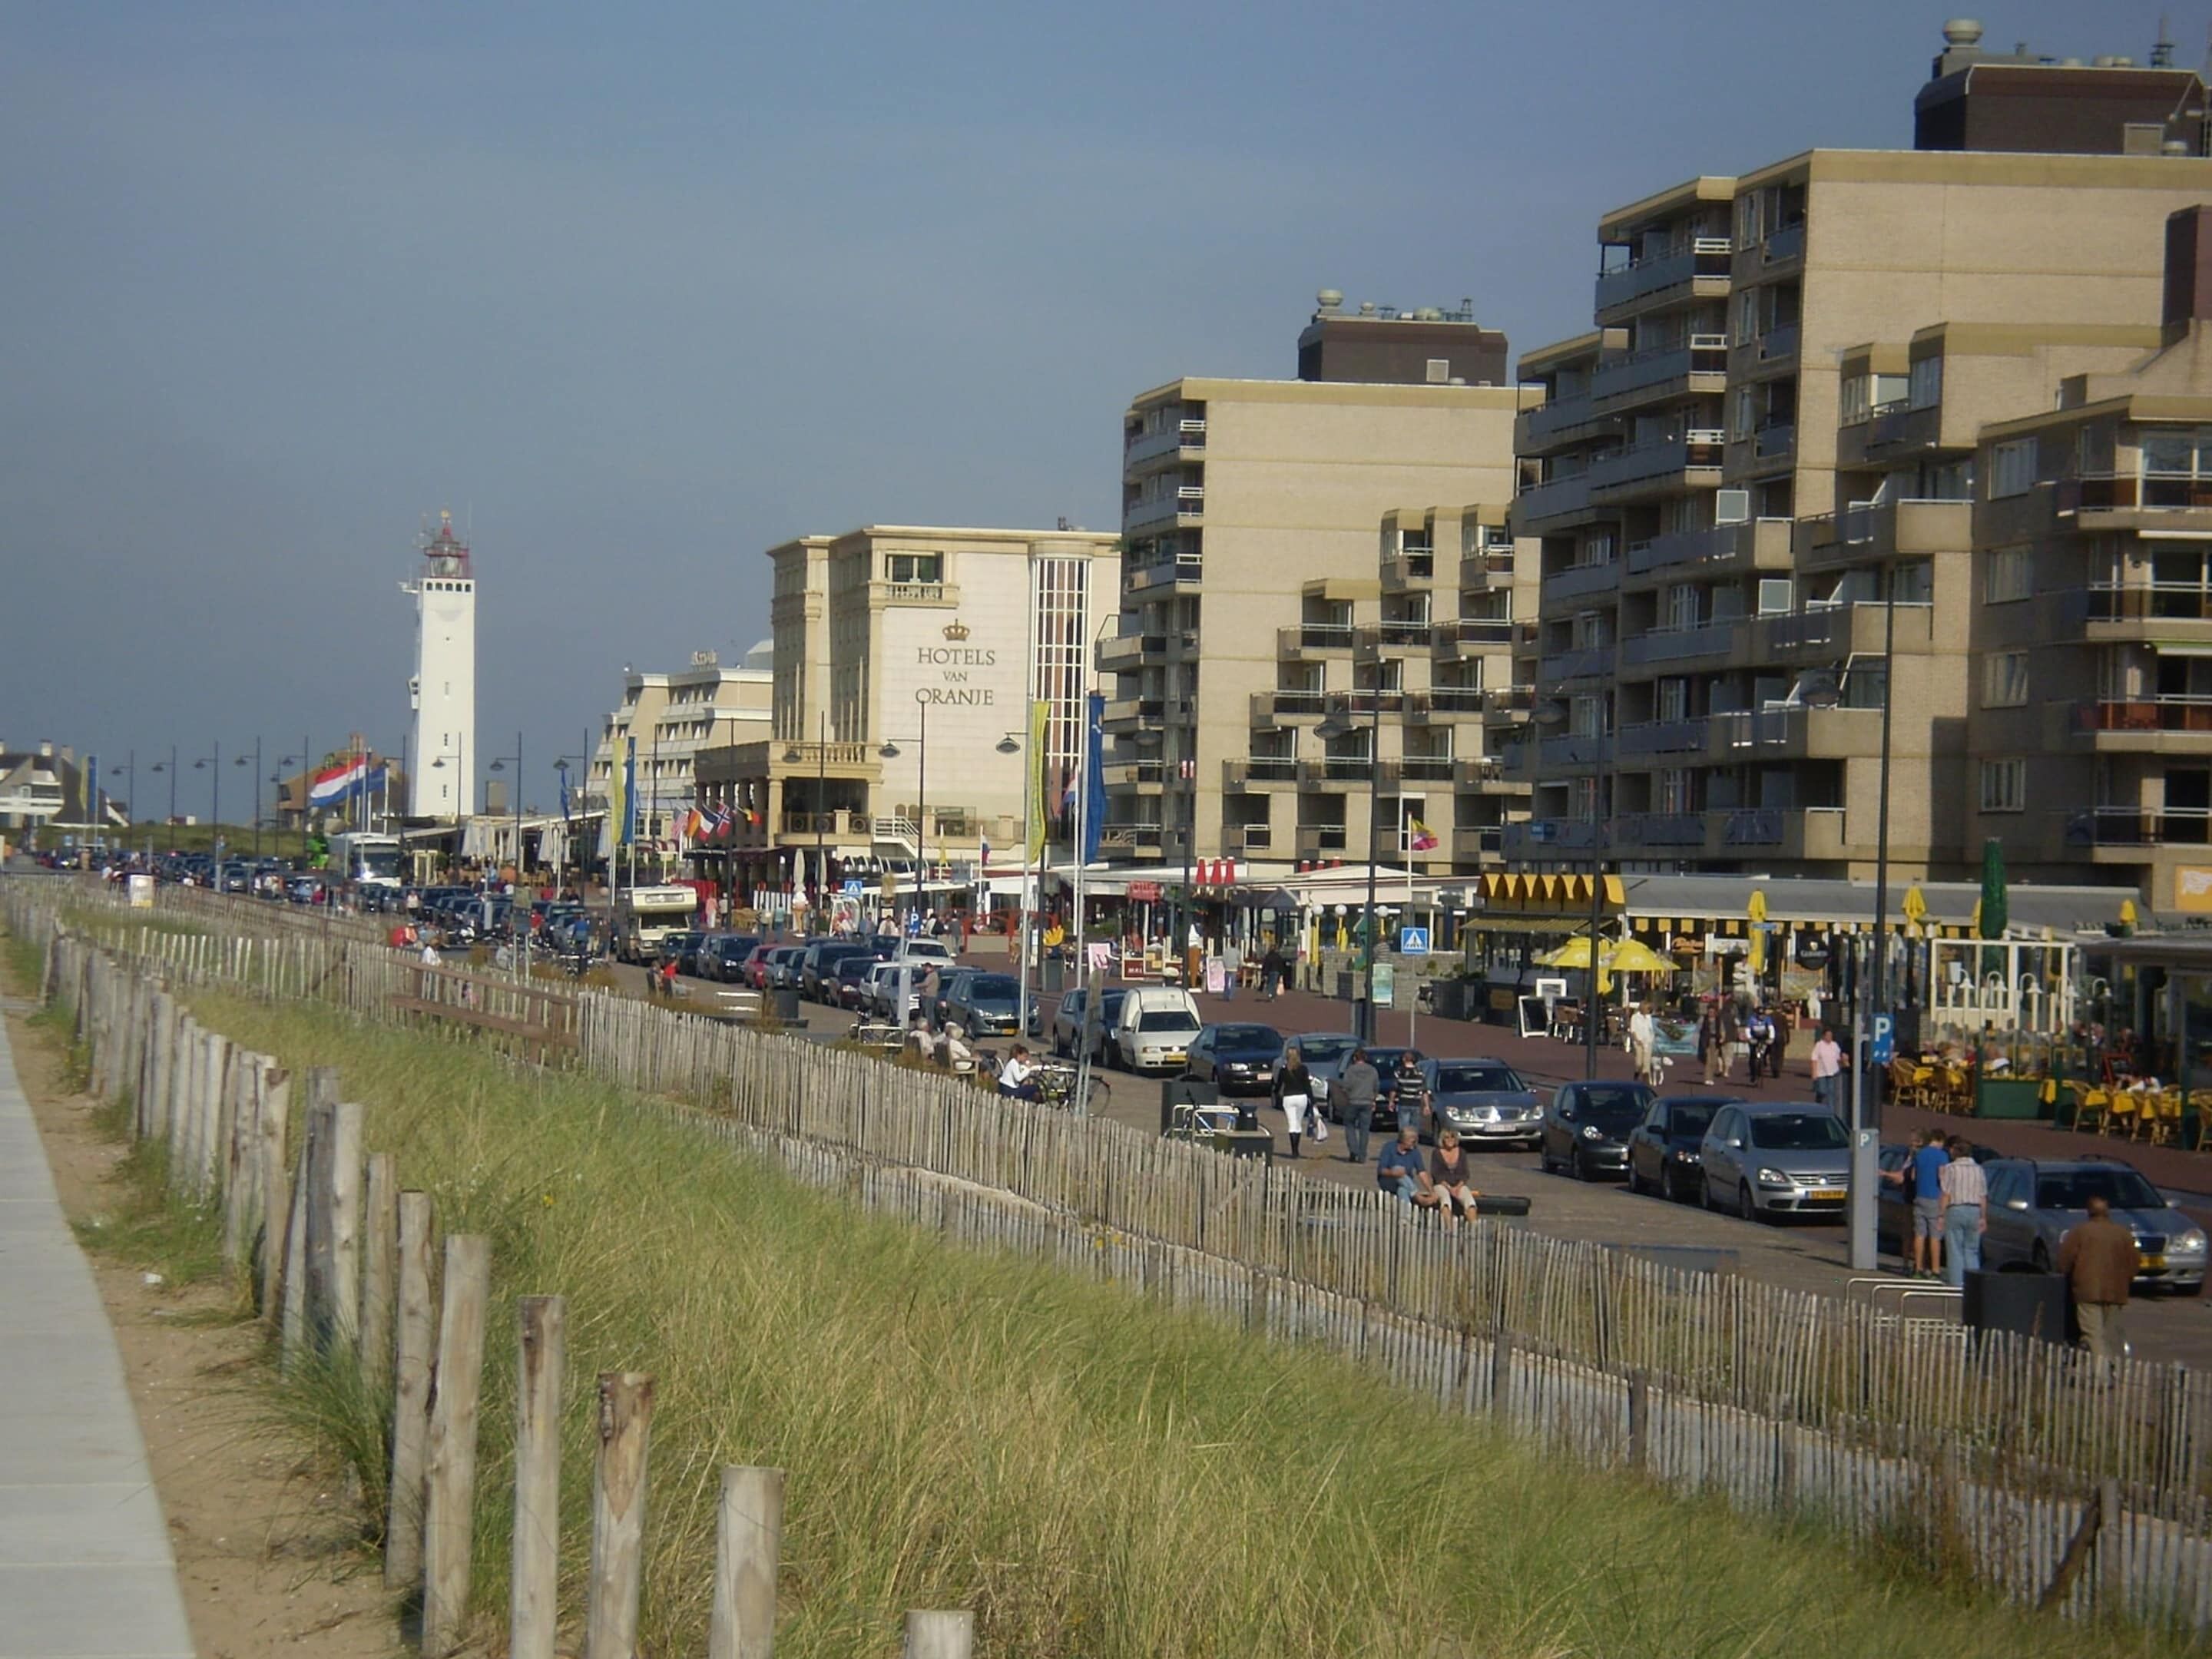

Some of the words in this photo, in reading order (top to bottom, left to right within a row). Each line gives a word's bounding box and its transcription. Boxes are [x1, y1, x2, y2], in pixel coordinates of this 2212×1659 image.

[917, 647, 995, 665] HOTELS
[942, 671, 968, 682] VAN
[915, 687, 994, 706] ORANJE
[910, 912, 919, 926] P
[1874, 1016, 1891, 1042] P
[1859, 1133, 1870, 1147] P
